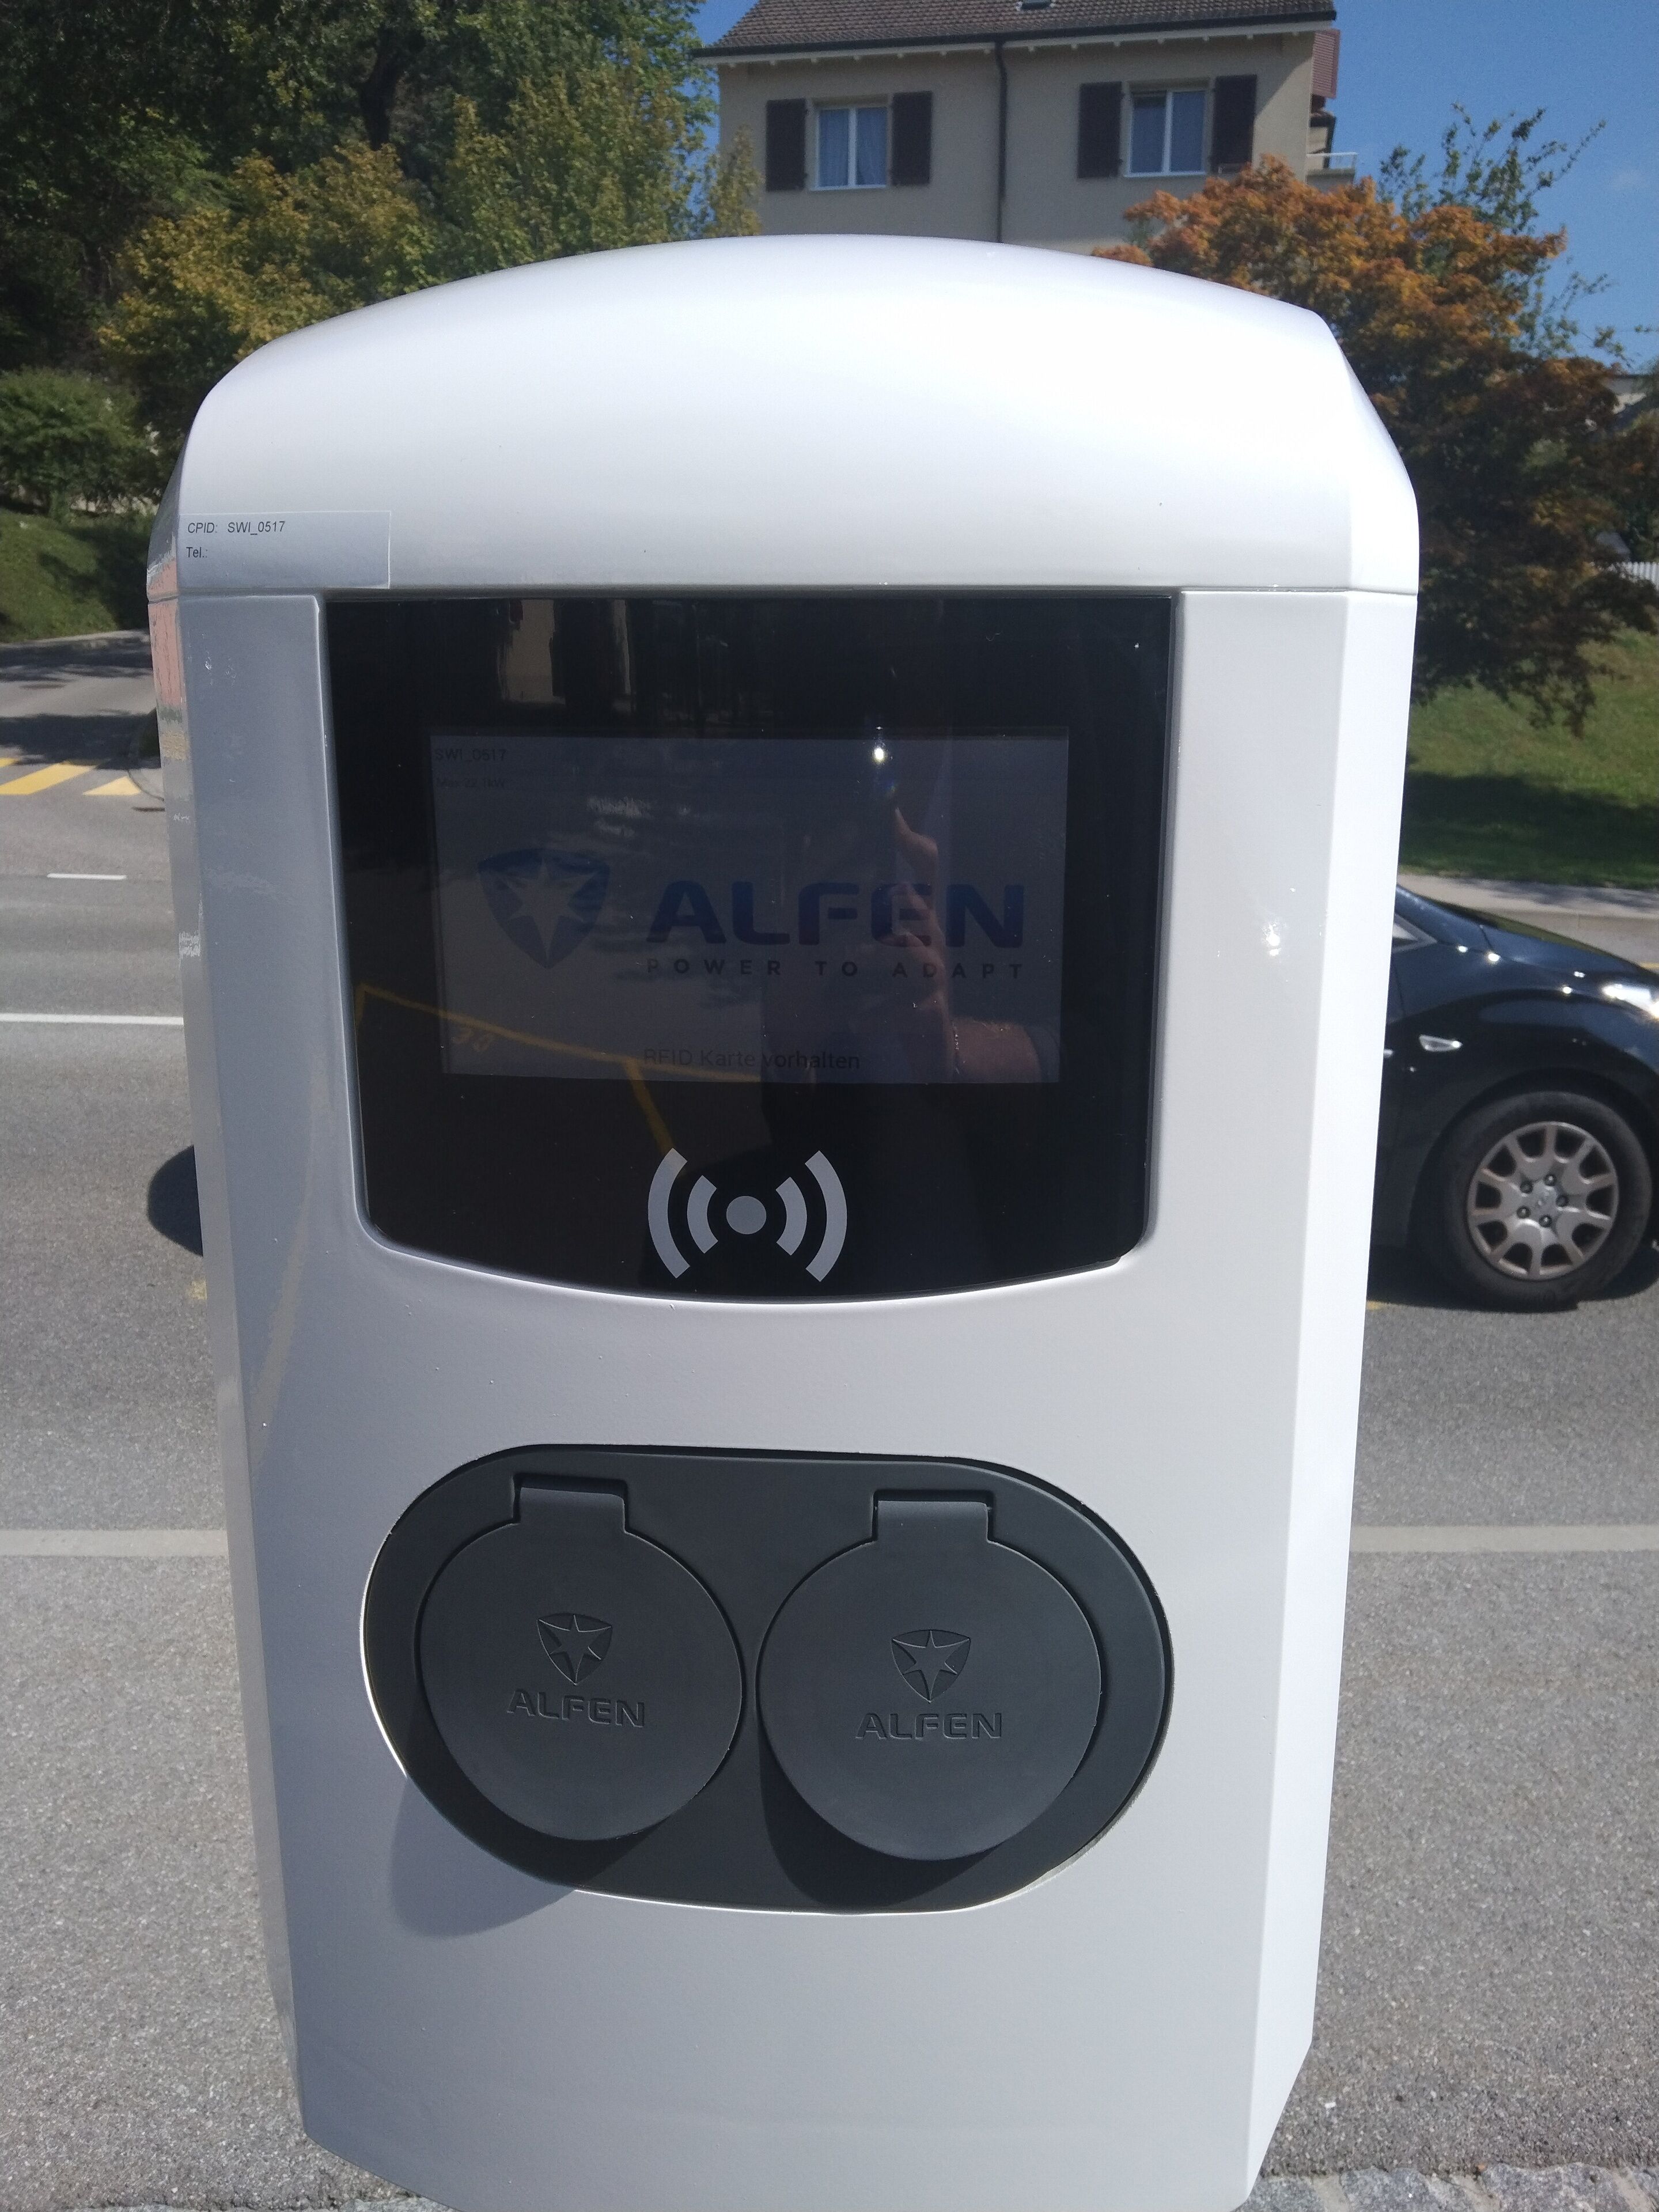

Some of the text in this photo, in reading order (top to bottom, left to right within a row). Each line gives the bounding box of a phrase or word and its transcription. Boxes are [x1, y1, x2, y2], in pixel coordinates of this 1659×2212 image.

[188, 521, 286, 535] CPID: SWI_0517
[434, 748, 506, 762] SWI_0517
[646, 880, 1024, 948] ALFEN
[647, 959, 1023, 979] POWER TO ADAPT
[644, 1048, 859, 1069] RFID Karte vorhalten
[507, 1688, 645, 1728] ALFEN
[855, 1713, 1002, 1740] ALFEN
